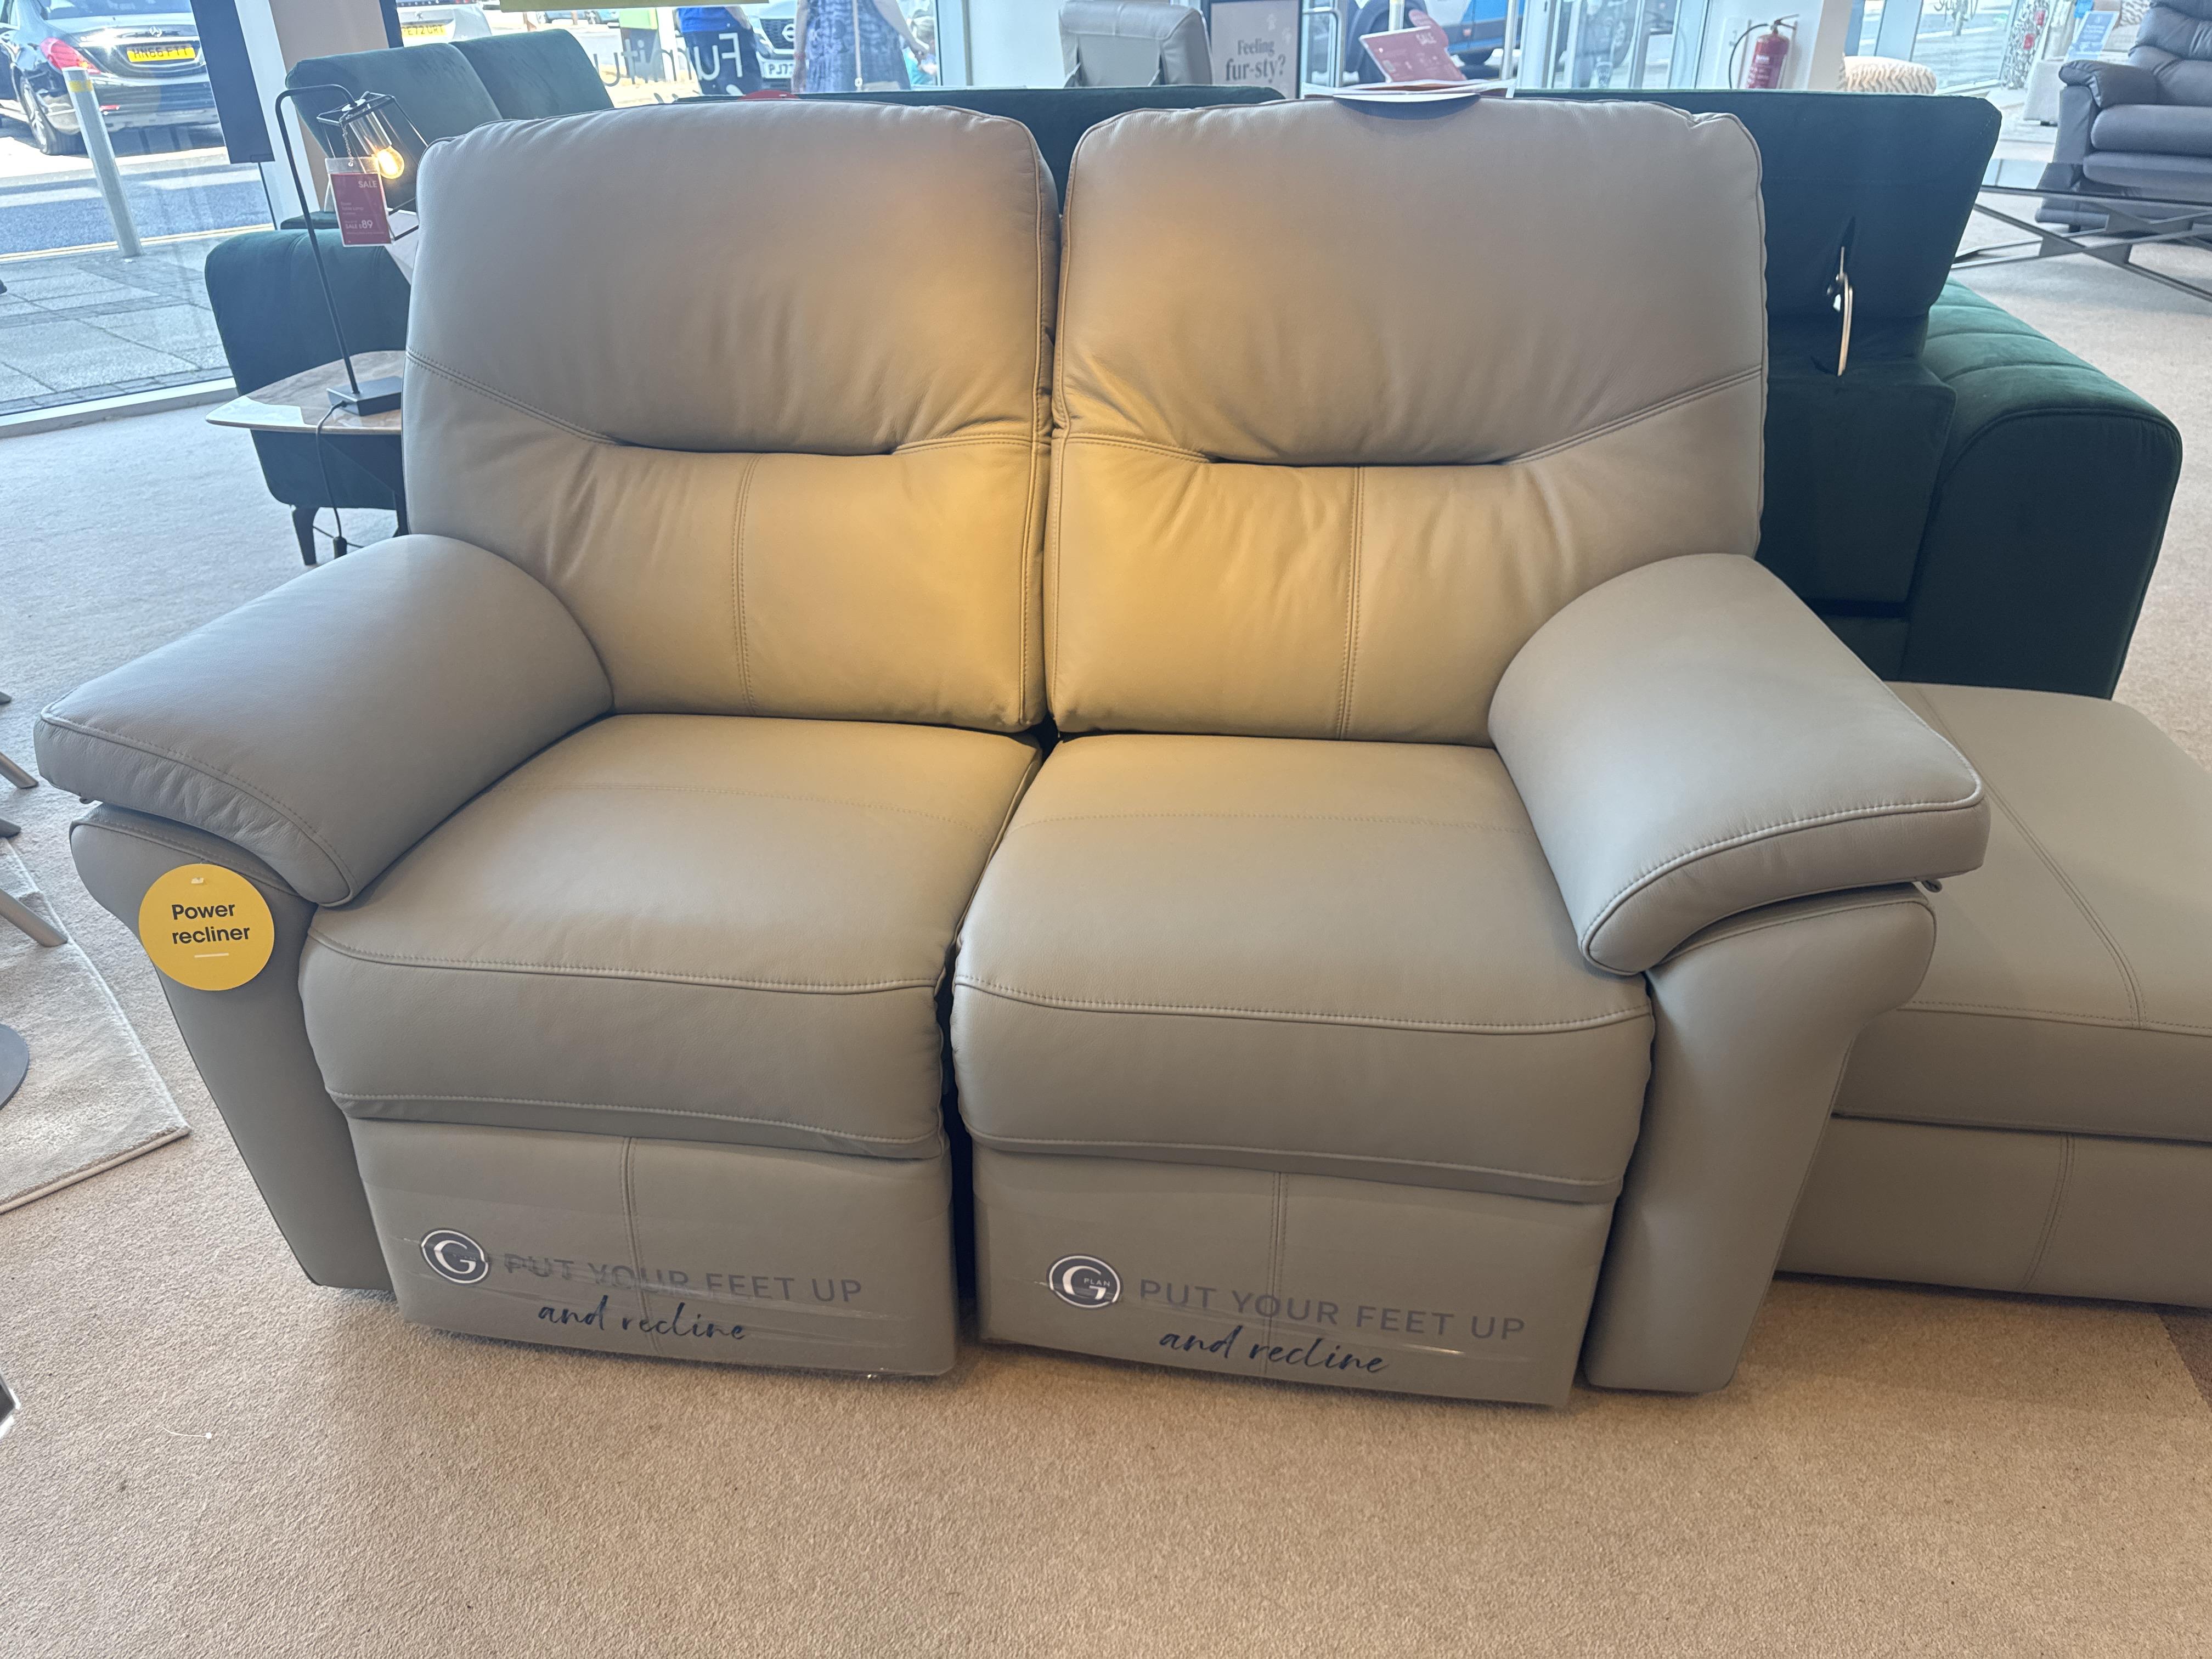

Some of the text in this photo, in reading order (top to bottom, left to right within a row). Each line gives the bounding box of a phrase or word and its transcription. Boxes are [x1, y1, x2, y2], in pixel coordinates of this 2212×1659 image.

[1237, 38, 1275, 57] Feeling
[1226, 54, 1286, 83] fur-sty?
[358, 180, 377, 188] SALE
[172, 904, 235, 920] Power
[172, 926, 250, 944] recliner
[433, 1240, 476, 1274] G
[504, 1253, 862, 1302] PUT YOUR FEET UP
[1062, 1265, 1107, 1300] G
[1084, 1277, 1110, 1286] PLAN
[538, 1295, 746, 1340] and recline
[1140, 1279, 1525, 1340] PUT YOUR FEET UP
[1159, 1325, 1389, 1373] and recline
